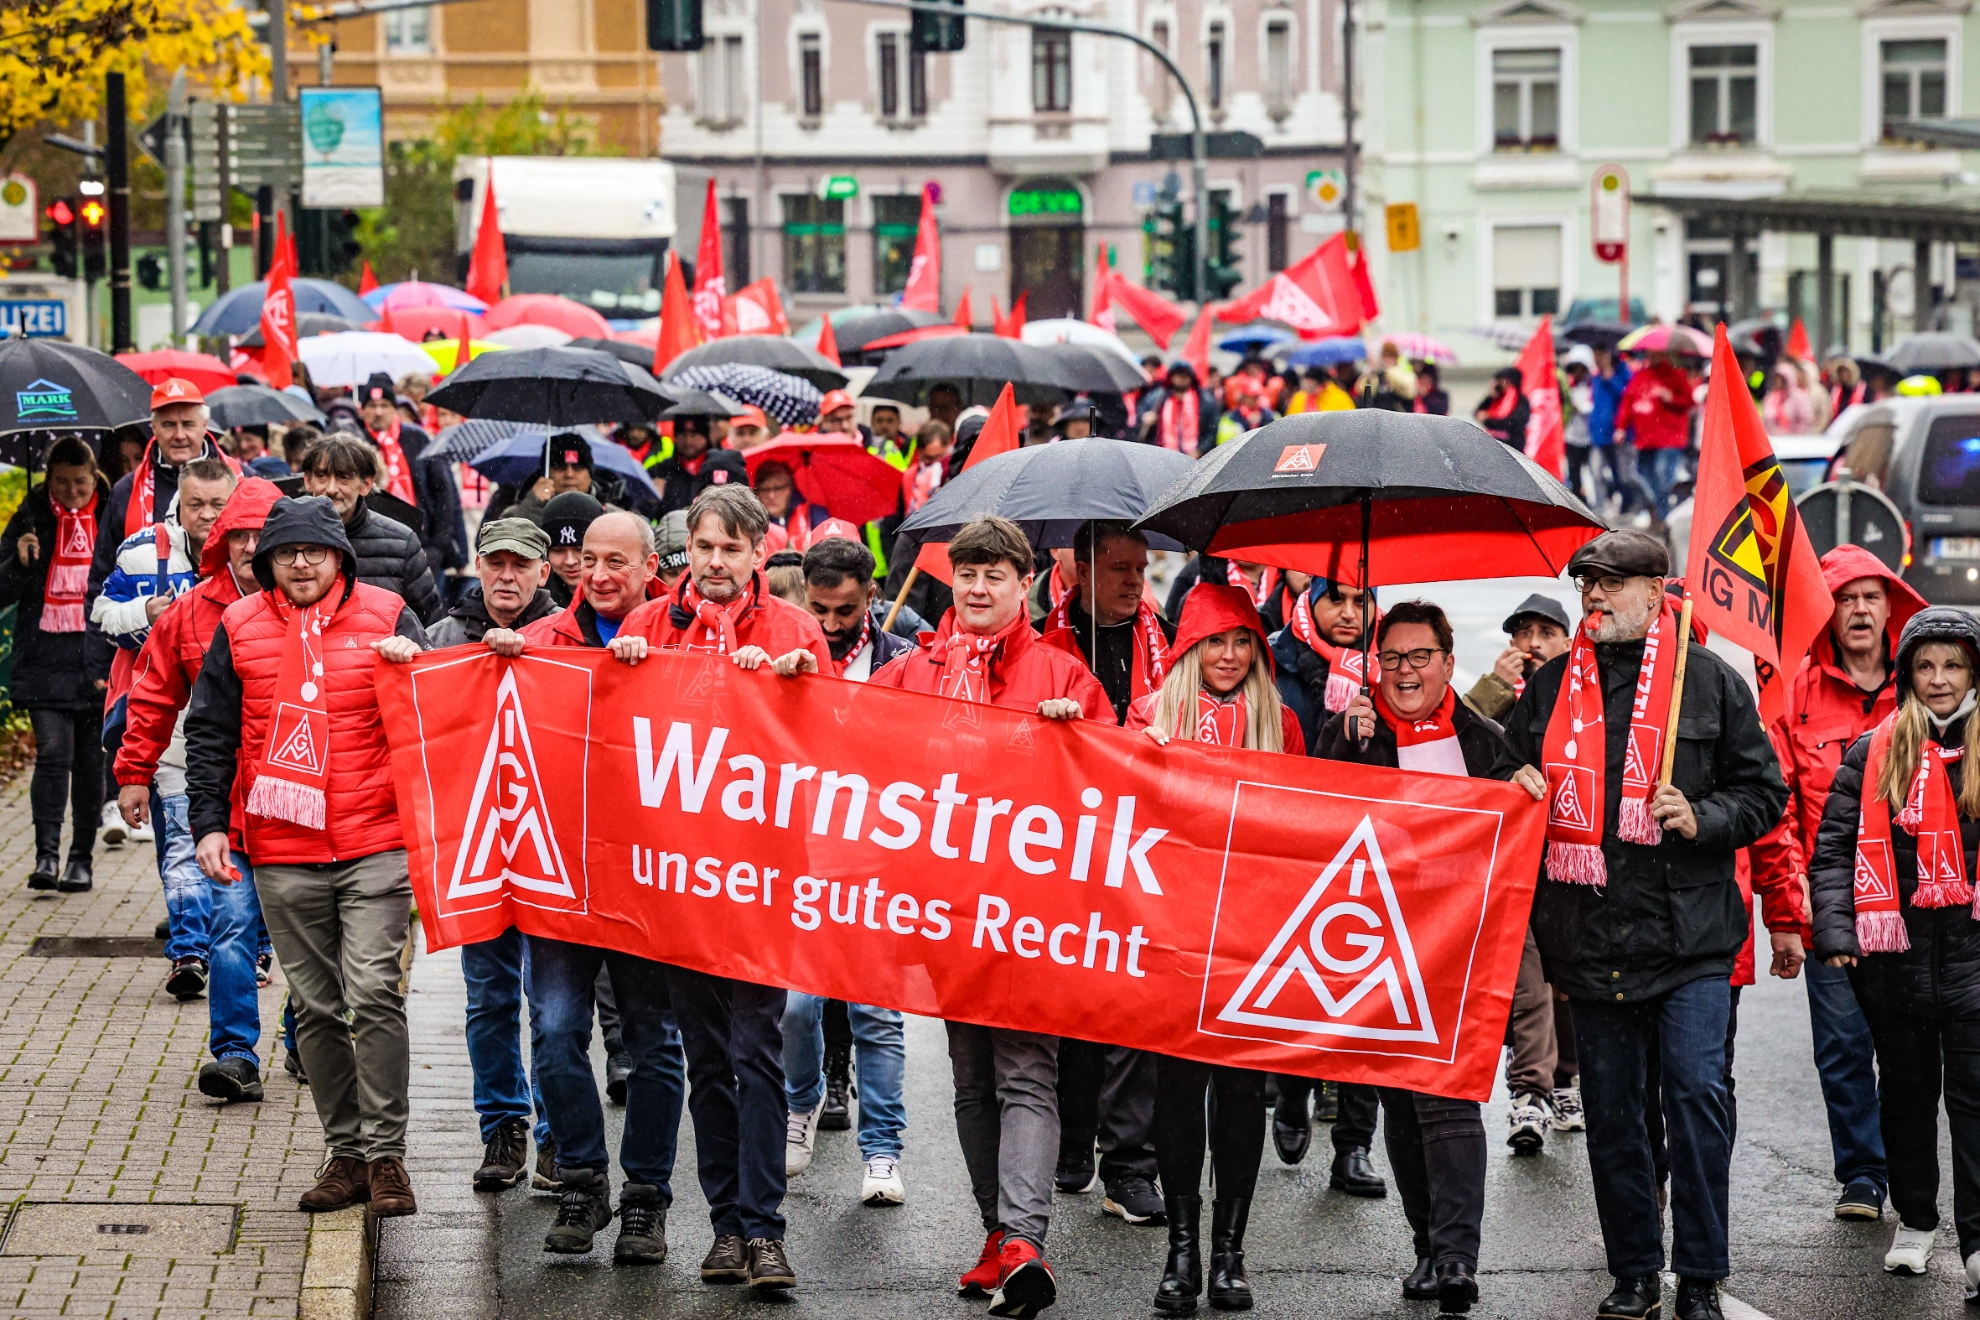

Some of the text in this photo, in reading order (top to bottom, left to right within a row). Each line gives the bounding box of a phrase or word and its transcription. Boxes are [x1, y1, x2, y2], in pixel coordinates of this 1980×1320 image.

[22, 394, 72, 405] MARK
[560, 526, 577, 544] NY
[632, 716, 1170, 896] Warnstreik
[632, 844, 1150, 978] unser gutes Recht
